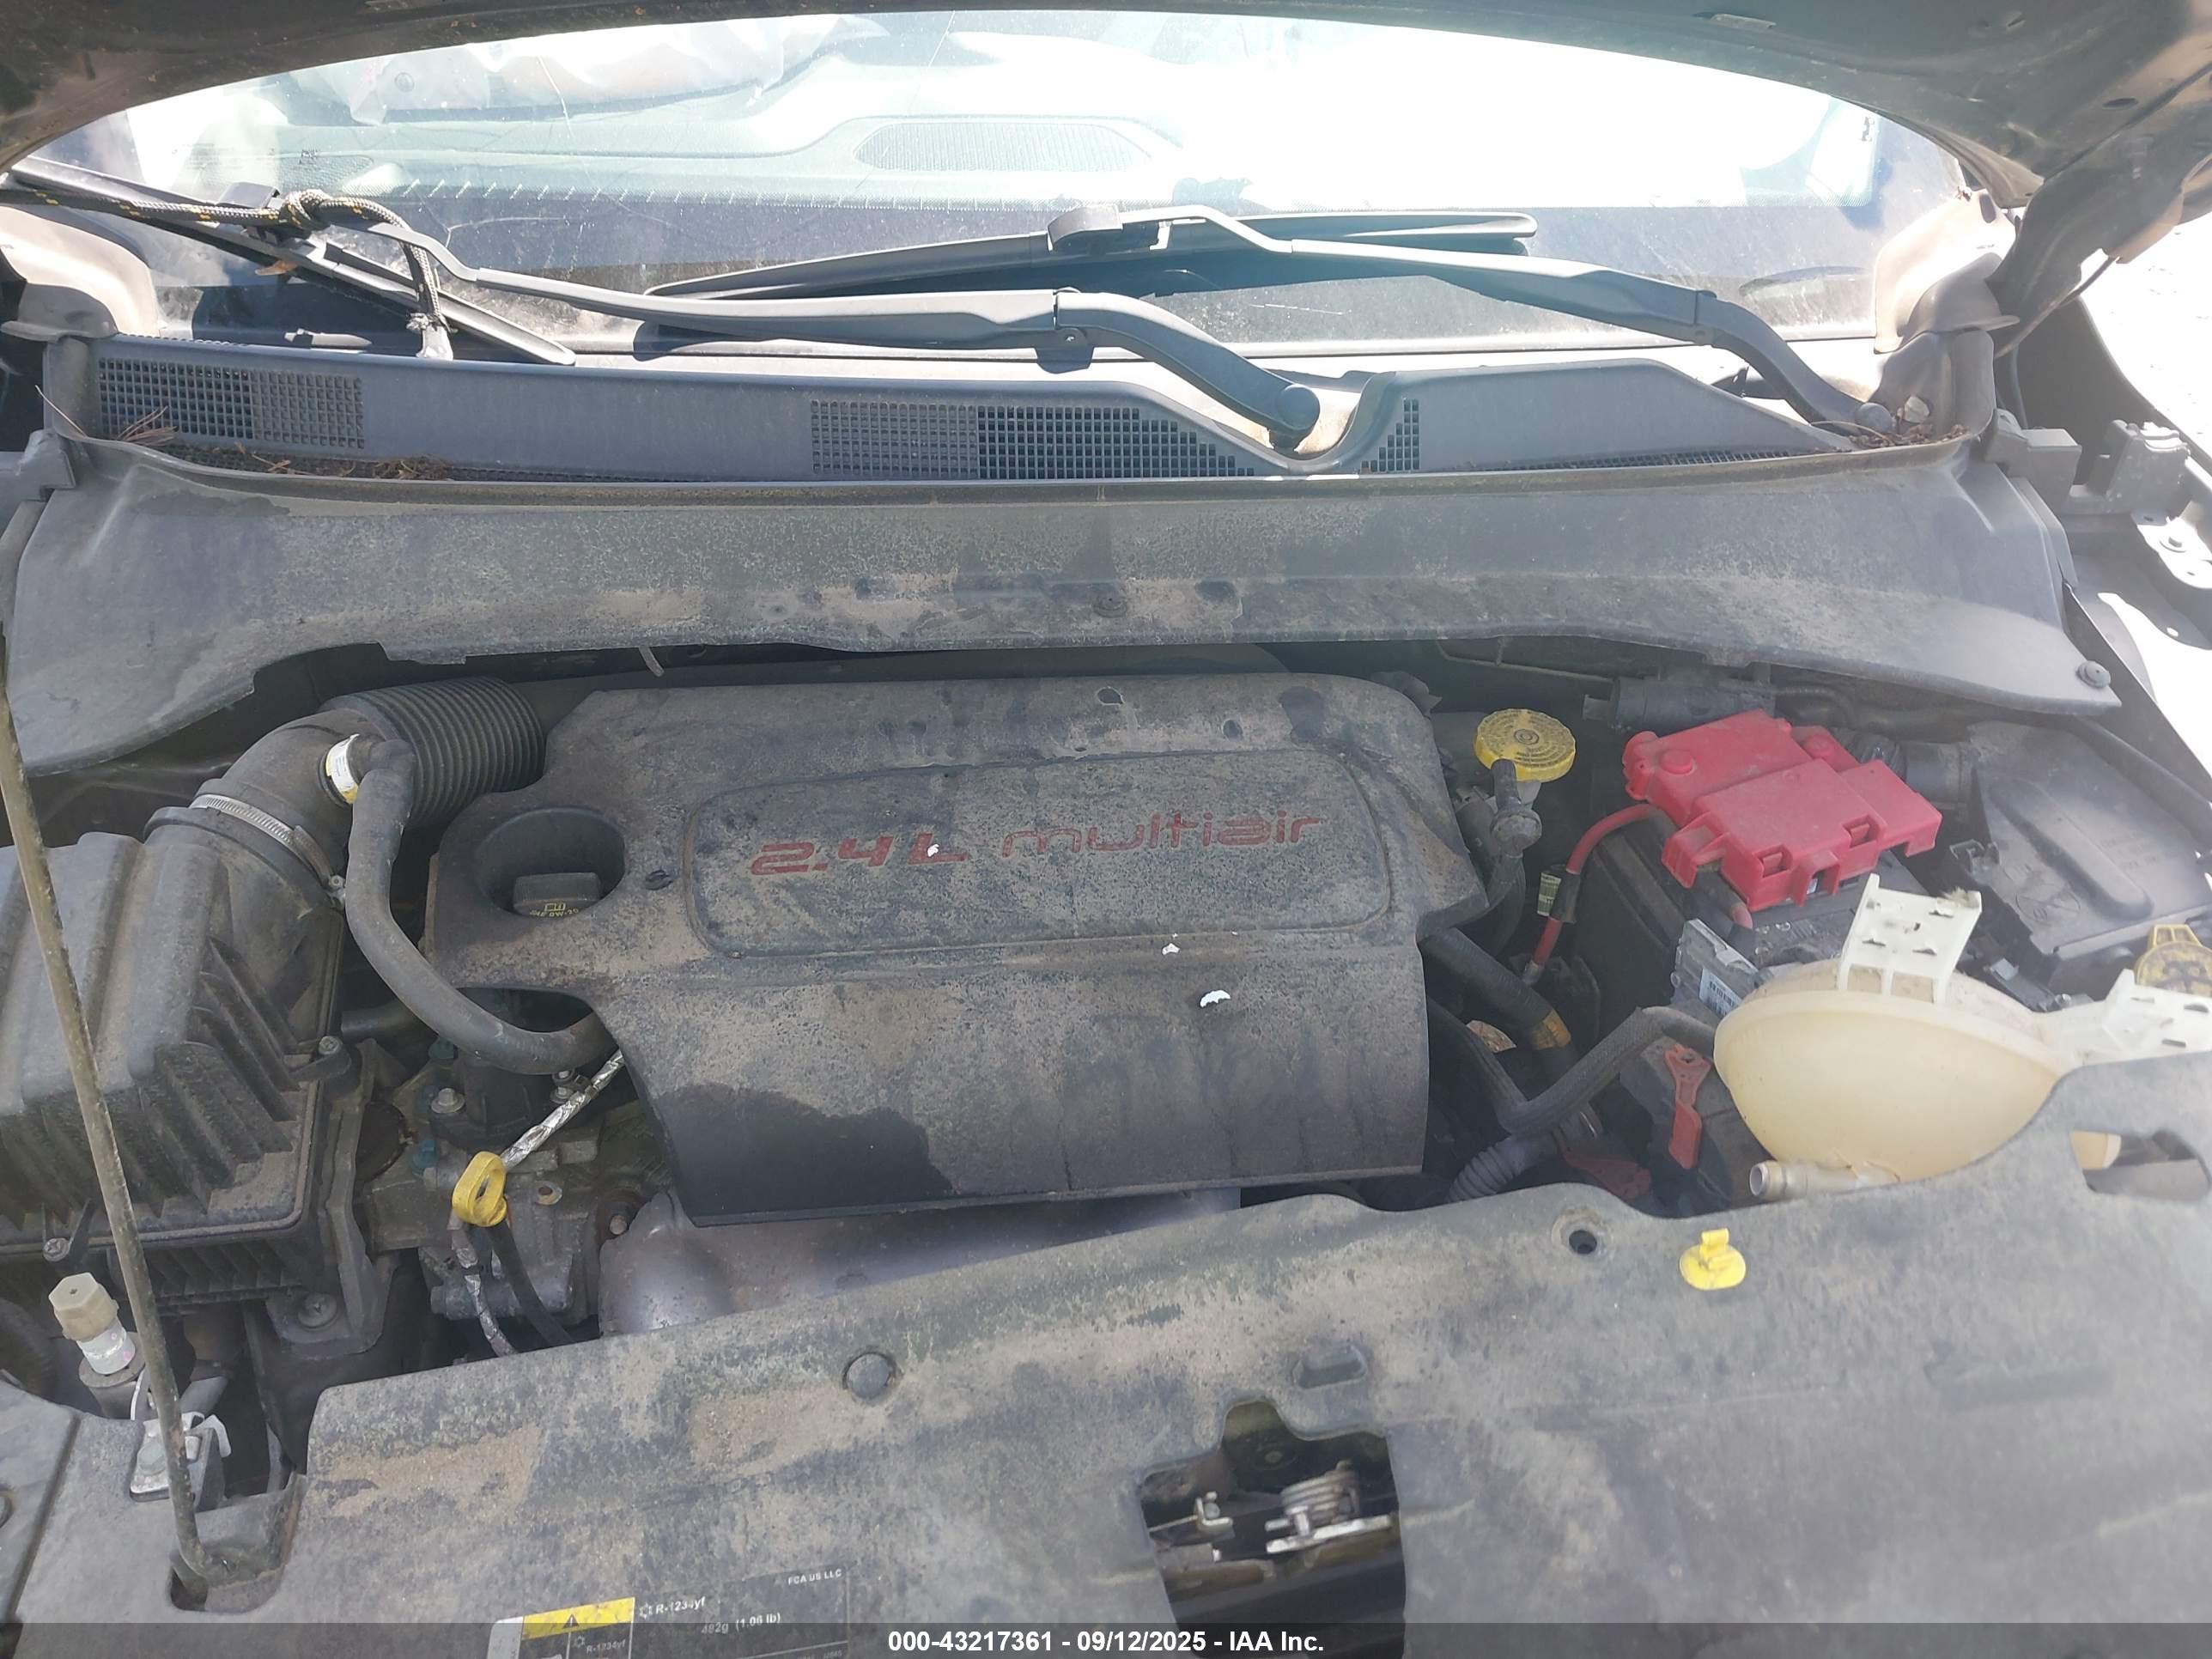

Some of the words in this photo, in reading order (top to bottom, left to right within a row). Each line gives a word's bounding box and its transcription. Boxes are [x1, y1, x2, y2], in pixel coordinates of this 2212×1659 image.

[1001, 811, 1320, 857] multiair
[788, 1574, 806, 1585] FCA
[809, 1572, 821, 1582] US
[823, 1568, 842, 1580] LLC
[766, 1612, 781, 1624] lb)
